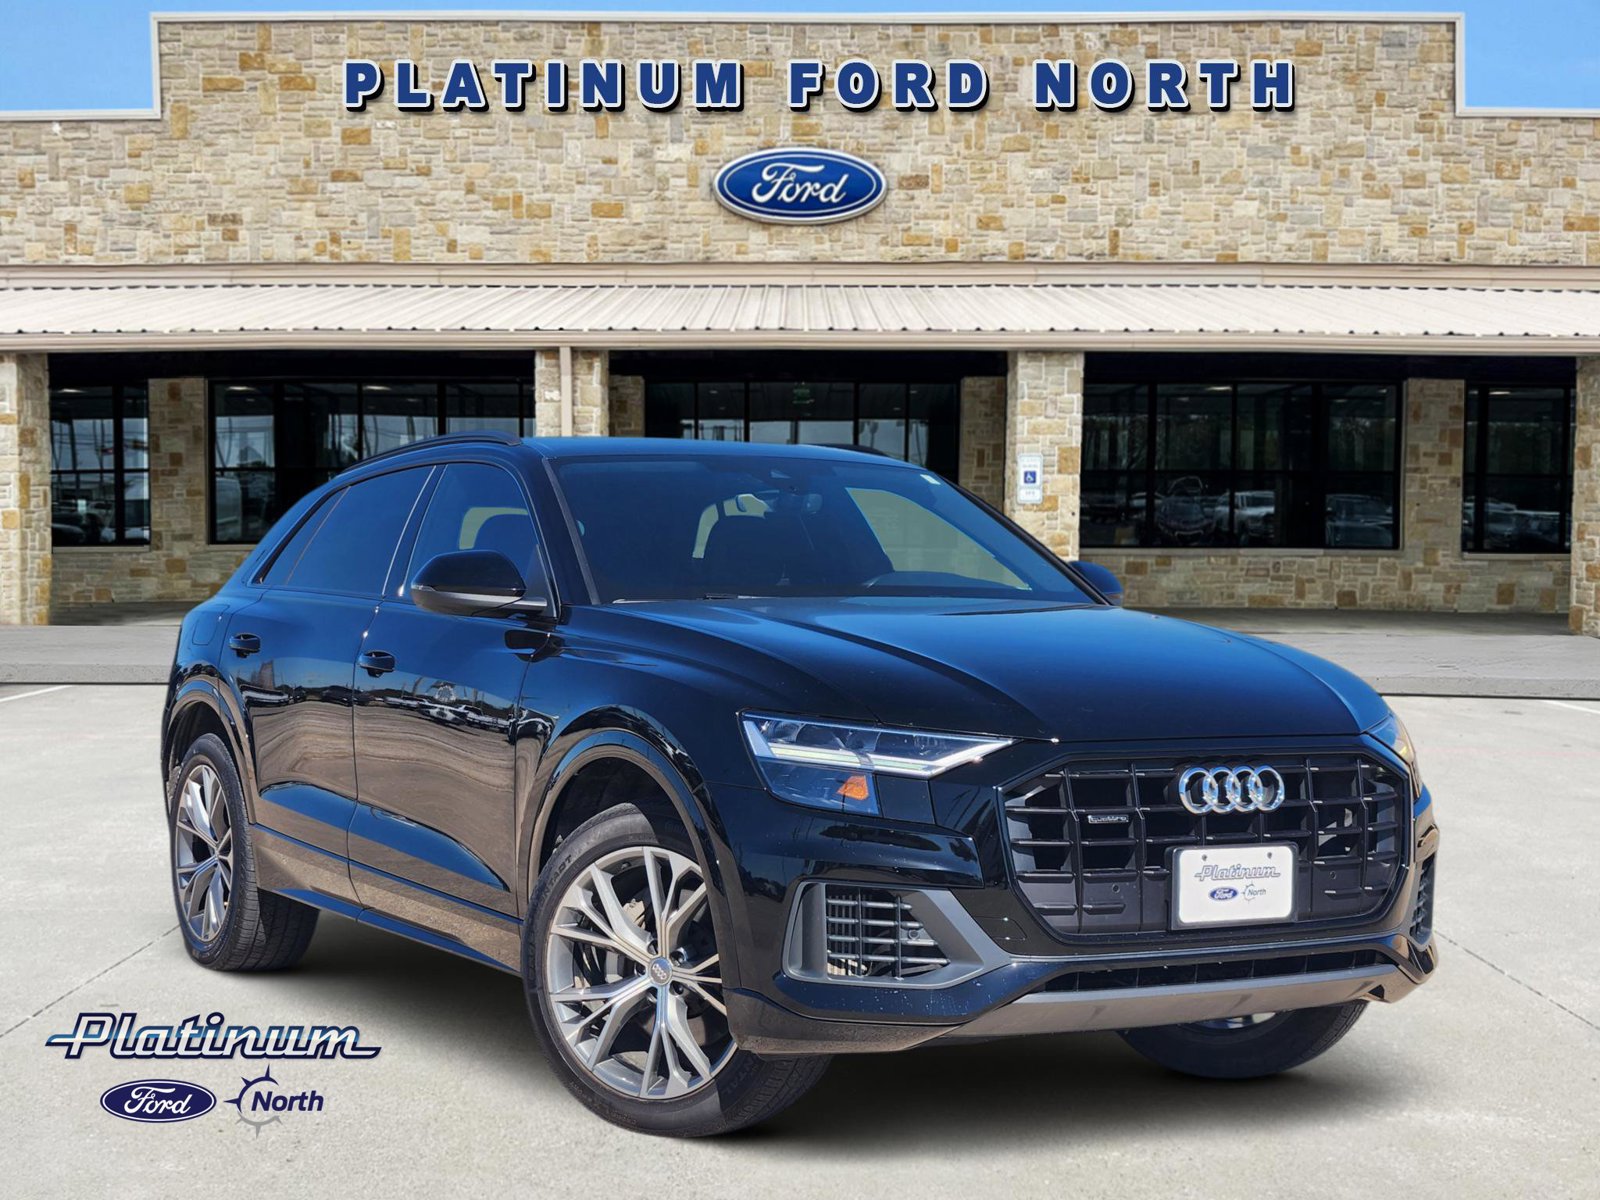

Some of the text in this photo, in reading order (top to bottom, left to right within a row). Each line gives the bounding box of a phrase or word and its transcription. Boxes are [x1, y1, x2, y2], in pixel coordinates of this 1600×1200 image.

[343, 58, 1295, 111] PLATINUM FORD NORTH
[751, 162, 849, 205] Ford
[1194, 863, 1281, 881] Platinum
[1247, 888, 1267, 896] North
